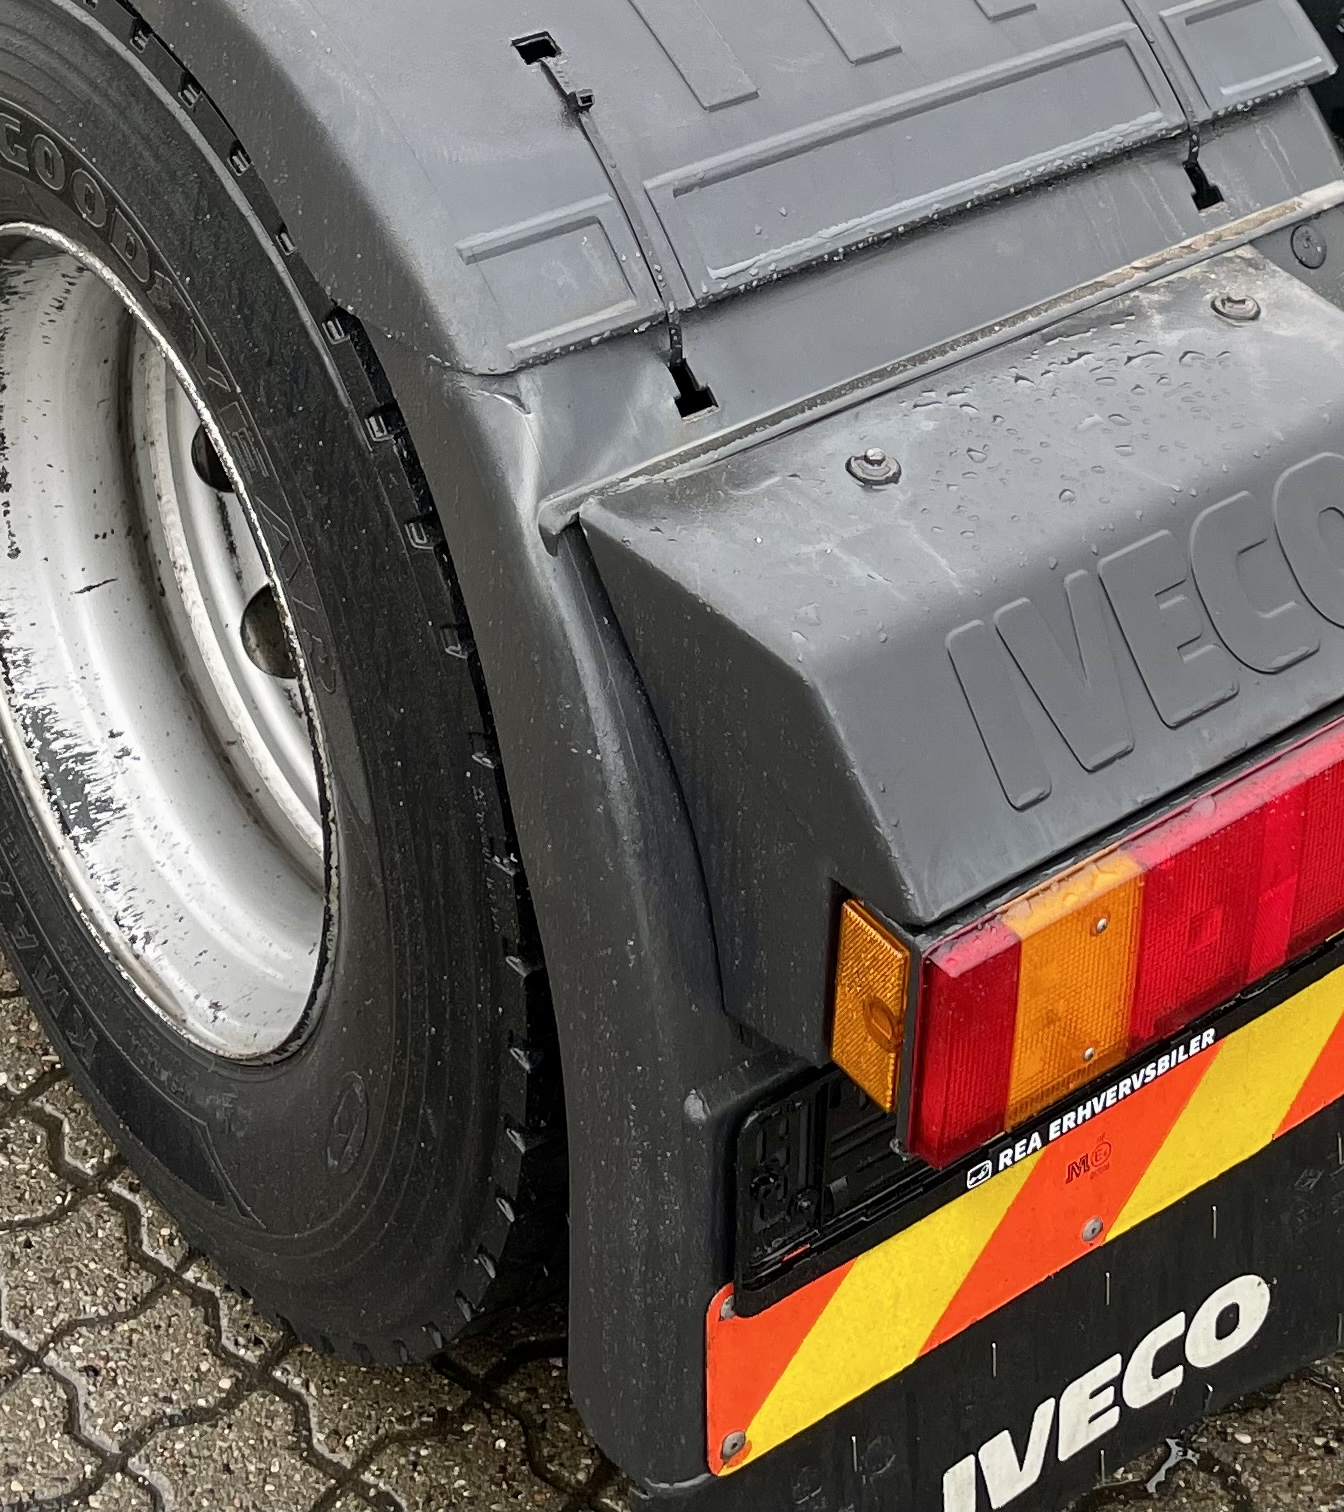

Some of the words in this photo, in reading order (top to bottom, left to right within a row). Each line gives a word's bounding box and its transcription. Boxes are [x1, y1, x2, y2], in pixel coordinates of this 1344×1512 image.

[998, 1132, 1041, 1172] REA
[1049, 1028, 1215, 1141] ERHVERVSBILER
[942, 1274, 1271, 1512] IVECO
